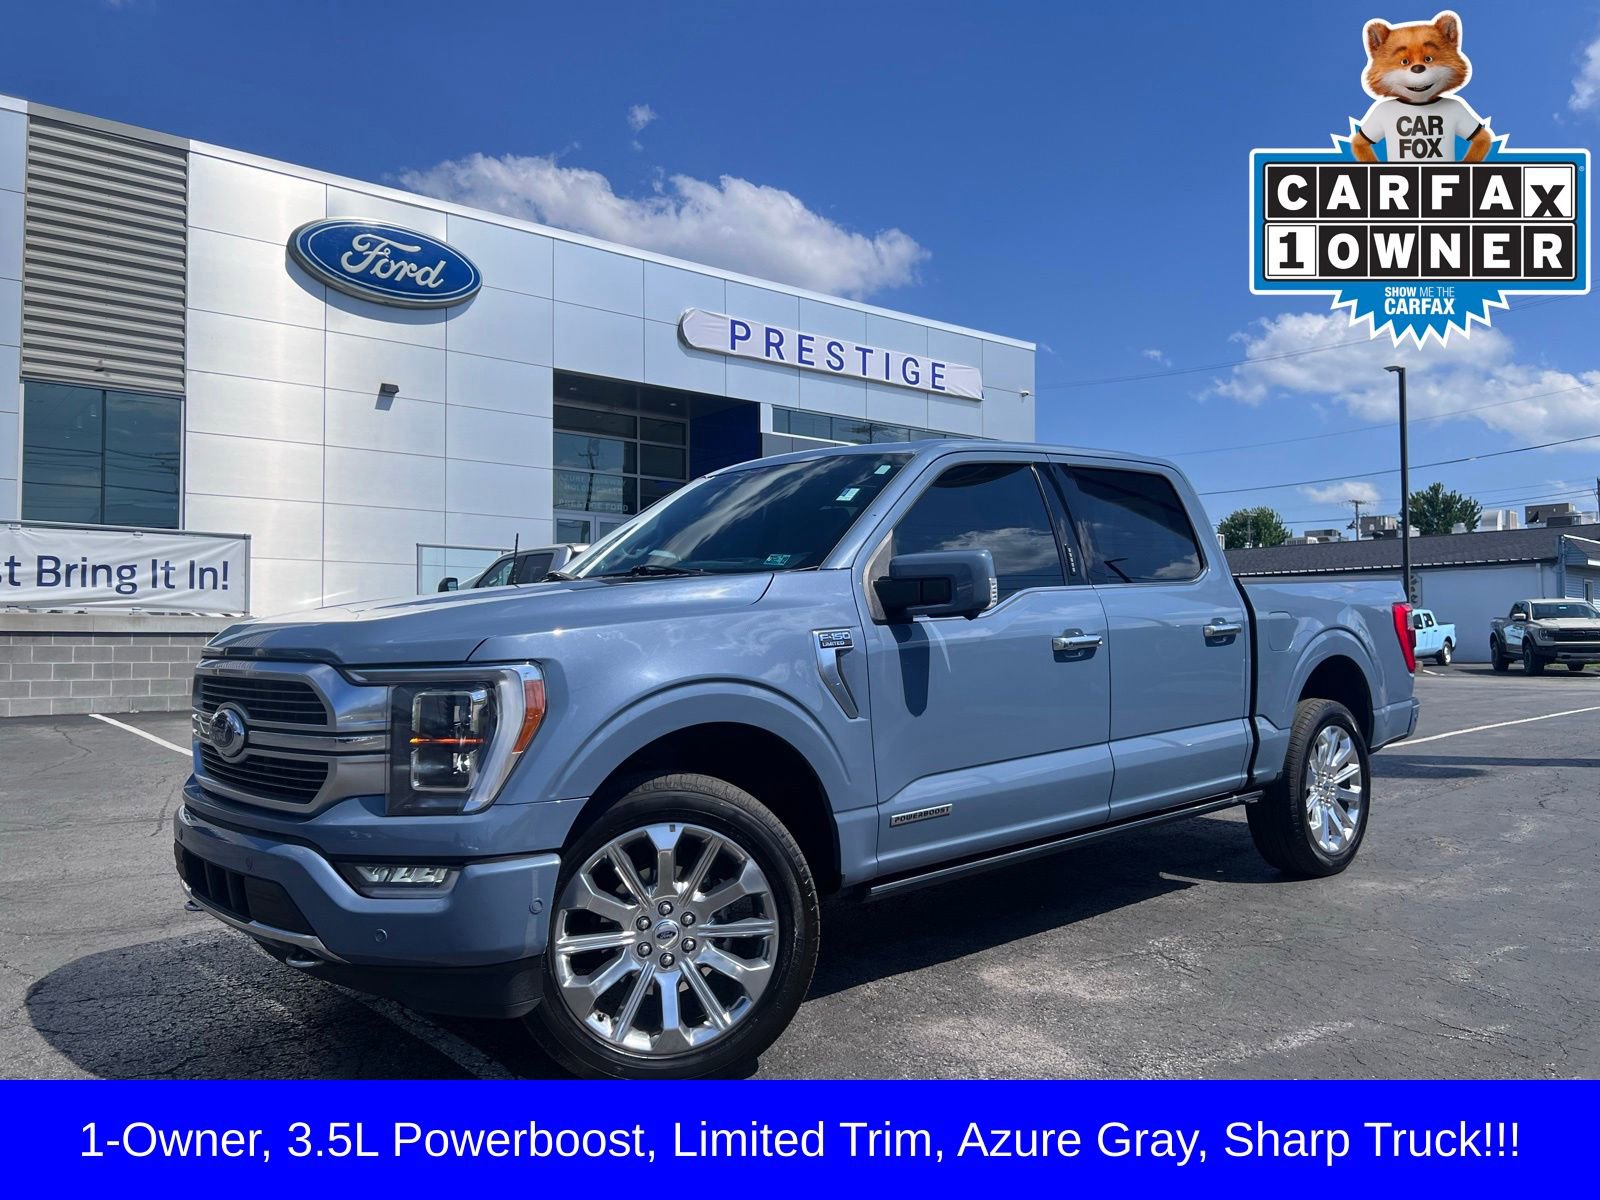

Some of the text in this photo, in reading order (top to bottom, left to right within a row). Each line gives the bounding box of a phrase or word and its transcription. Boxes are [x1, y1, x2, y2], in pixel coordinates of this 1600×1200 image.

[340, 233, 446, 289] Ford
[730, 319, 946, 391] PRESTIGE
[36, 555, 138, 595] Bring
[151, 559, 176, 589] It
[189, 559, 229, 590] In!
[820, 631, 851, 641] F-150
[894, 806, 950, 823] POWERBOOST
